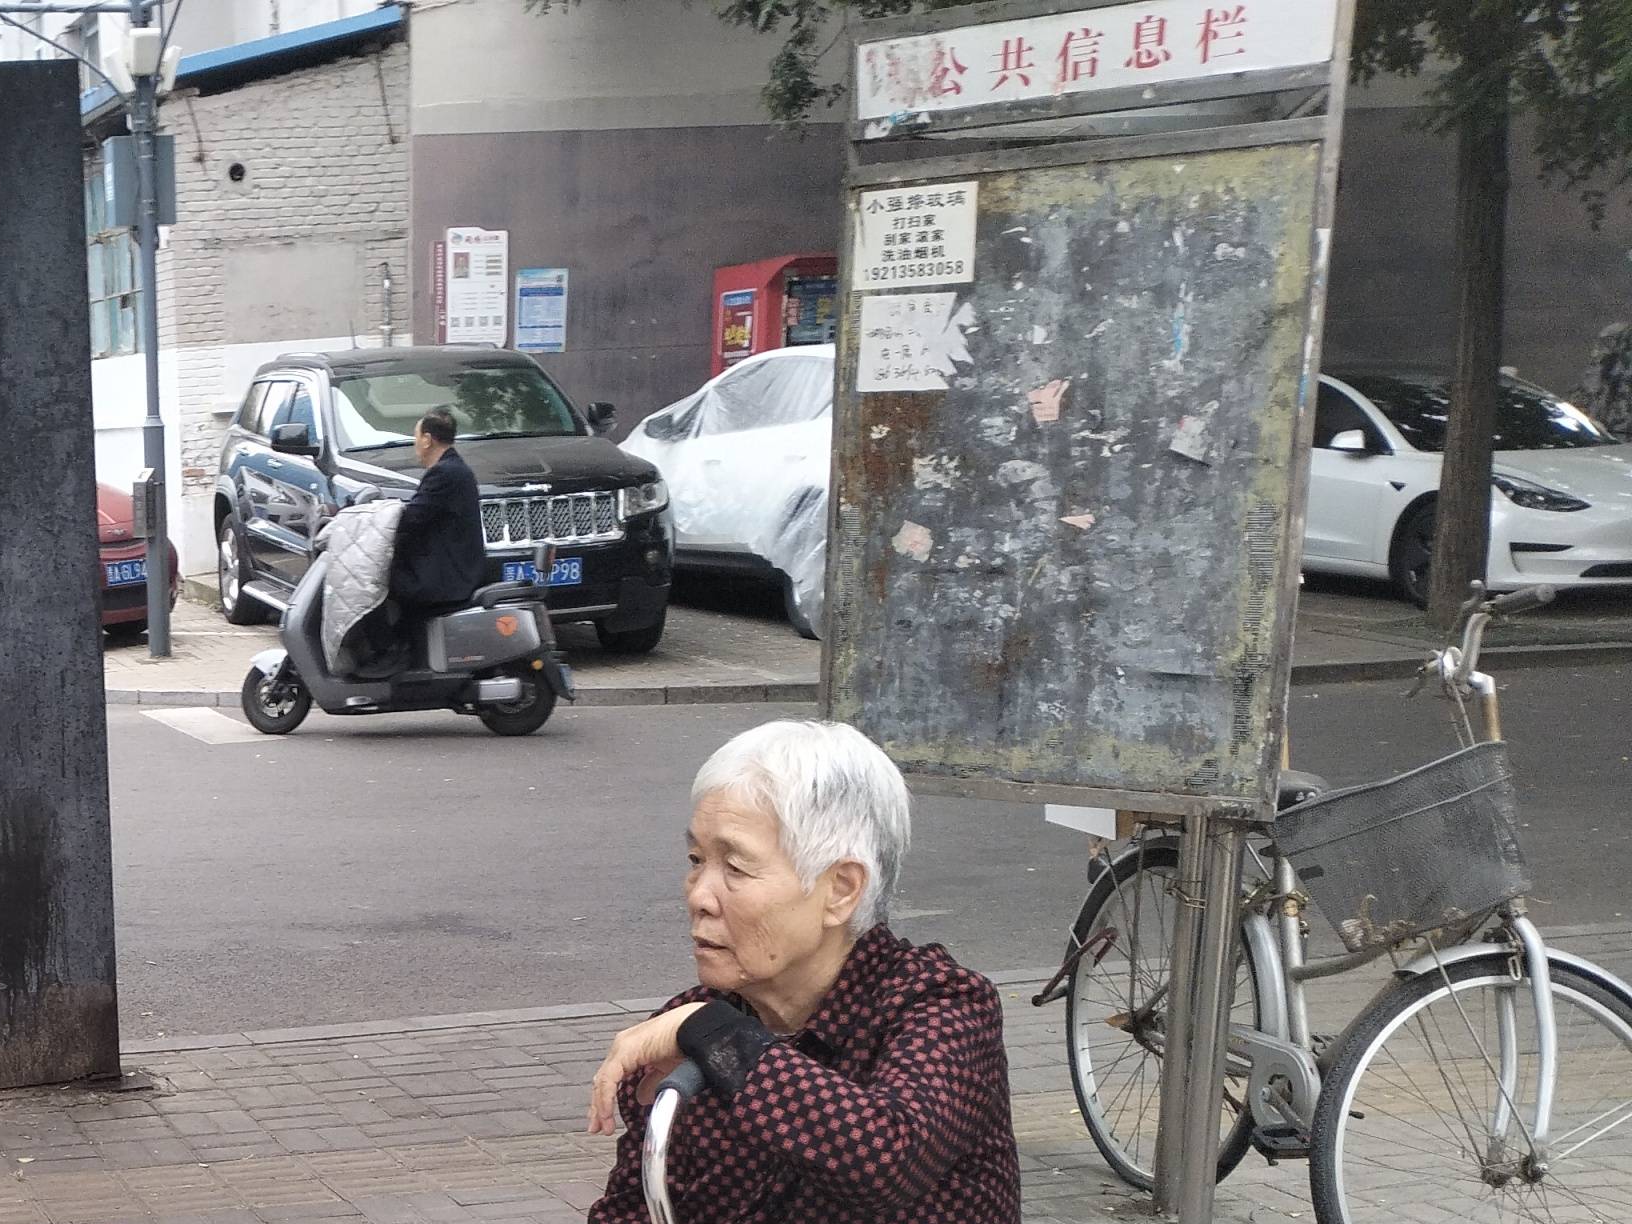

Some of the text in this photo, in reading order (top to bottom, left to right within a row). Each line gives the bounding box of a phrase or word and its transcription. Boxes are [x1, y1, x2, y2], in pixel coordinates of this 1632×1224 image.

[926, 4, 1248, 98] 公共信息栏
[881, 245, 946, 262] 洗油烟机
